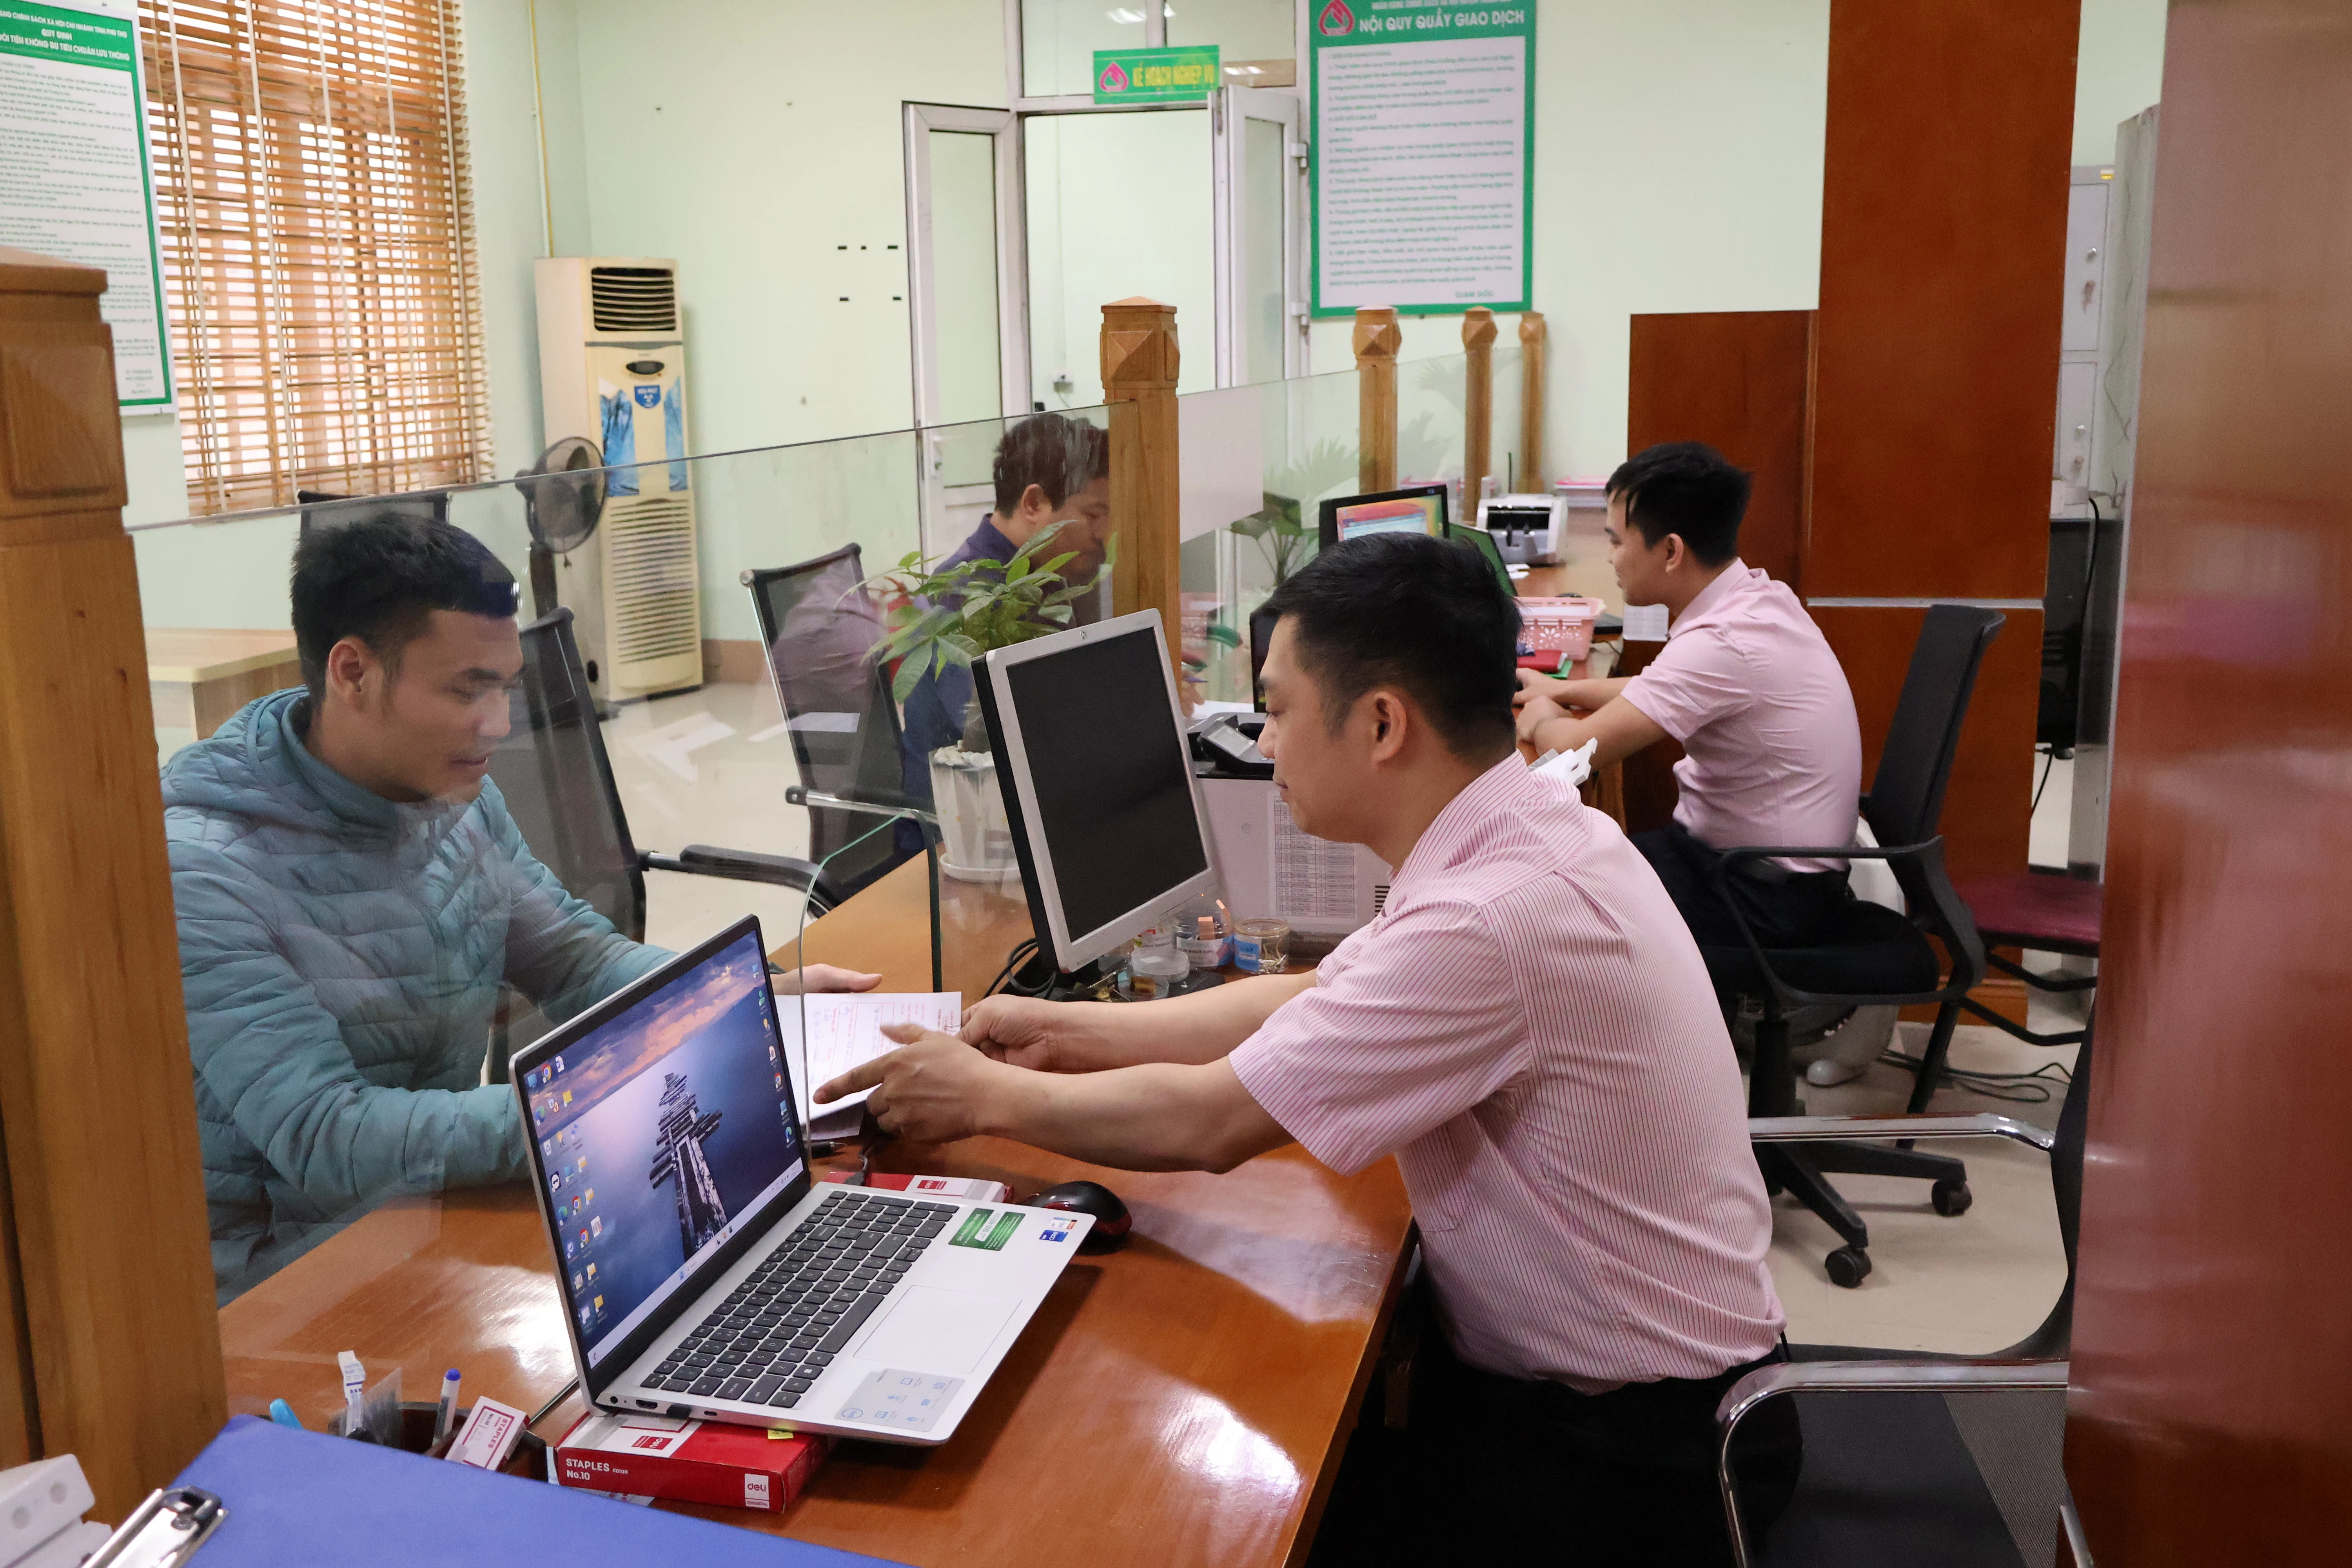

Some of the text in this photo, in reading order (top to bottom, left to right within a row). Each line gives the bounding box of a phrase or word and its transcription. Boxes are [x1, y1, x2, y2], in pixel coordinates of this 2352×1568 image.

[1359, 15, 1383, 35] NỘI
[1386, 16, 1412, 31] QUY
[1455, 11, 1488, 27] GIAO
[1492, 10, 1525, 28] DỊCH
[41, 28, 55, 38] QUY
[488, 1418, 508, 1448] STAPLES
[649, 1438, 663, 1448] deli
[566, 1458, 610, 1472] STAPLES
[566, 1469, 590, 1480] No.10
[747, 1483, 766, 1492] deli
